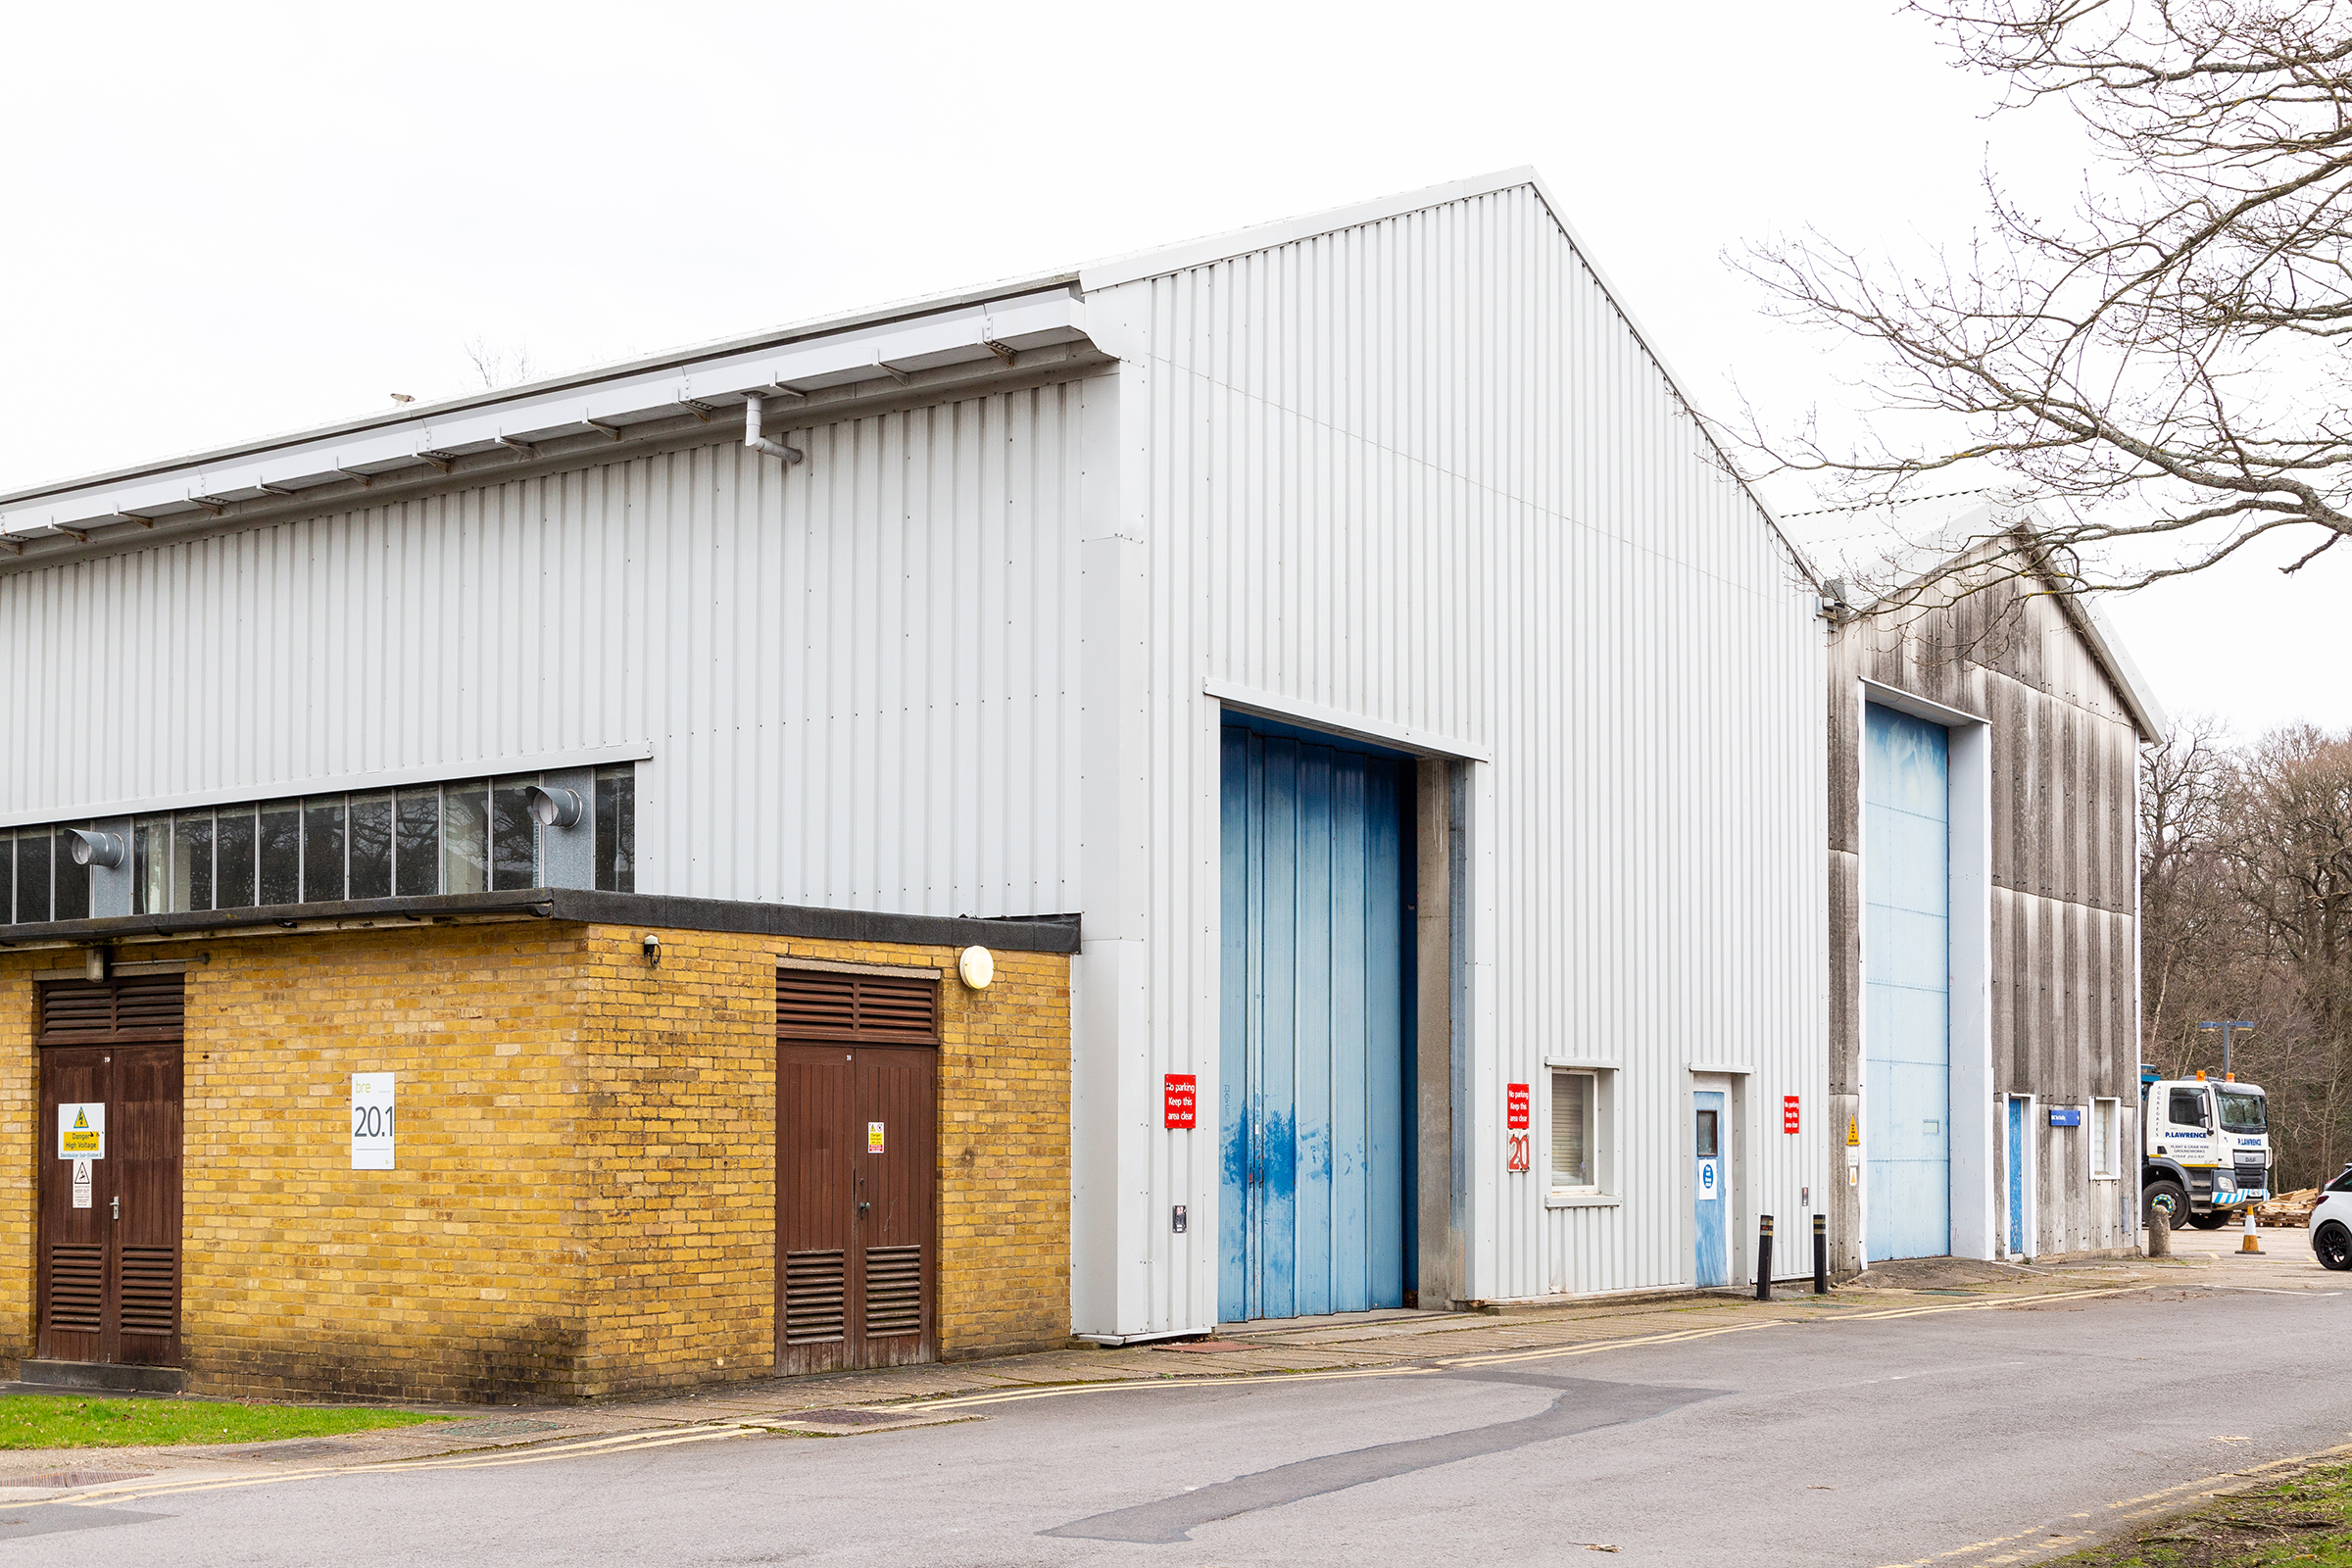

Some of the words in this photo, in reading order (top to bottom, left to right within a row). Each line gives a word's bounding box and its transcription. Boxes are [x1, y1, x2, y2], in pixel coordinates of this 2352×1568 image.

[355, 1080, 370, 1094] bre
[1166, 1082, 1174, 1091] No
[1175, 1082, 1195, 1094] parking
[1515, 1091, 1529, 1100] parking
[1168, 1097, 1182, 1107] Keep
[1183, 1097, 1193, 1105] this
[1509, 1102, 1520, 1111] Keep
[1180, 1110, 1194, 1120] clear
[354, 1105, 392, 1137] 20.1
[2237, 1138, 2262, 1147] P.LAWRENCE
[1509, 1135, 1530, 1170] 20
